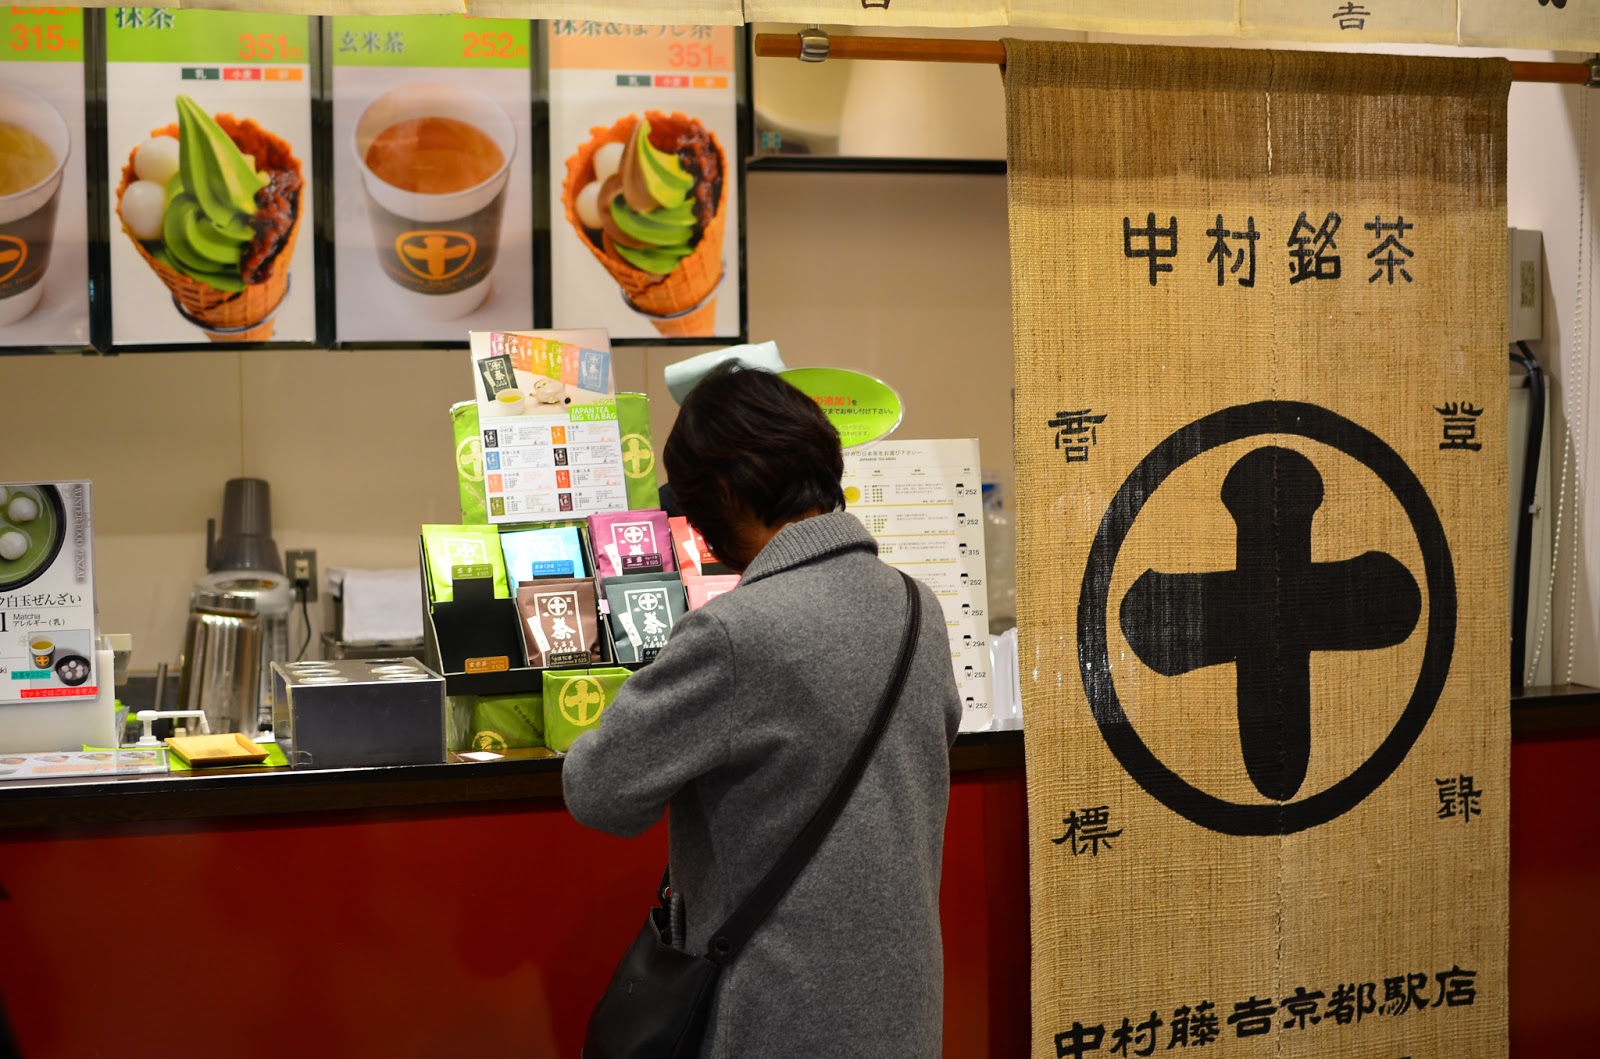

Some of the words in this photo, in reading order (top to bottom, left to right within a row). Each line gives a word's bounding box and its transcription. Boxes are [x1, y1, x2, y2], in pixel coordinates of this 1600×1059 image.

[338, 32, 404, 53] 玄米茶
[1124, 211, 1415, 287] 中村銘茶
[601, 412, 617, 420] BAG
